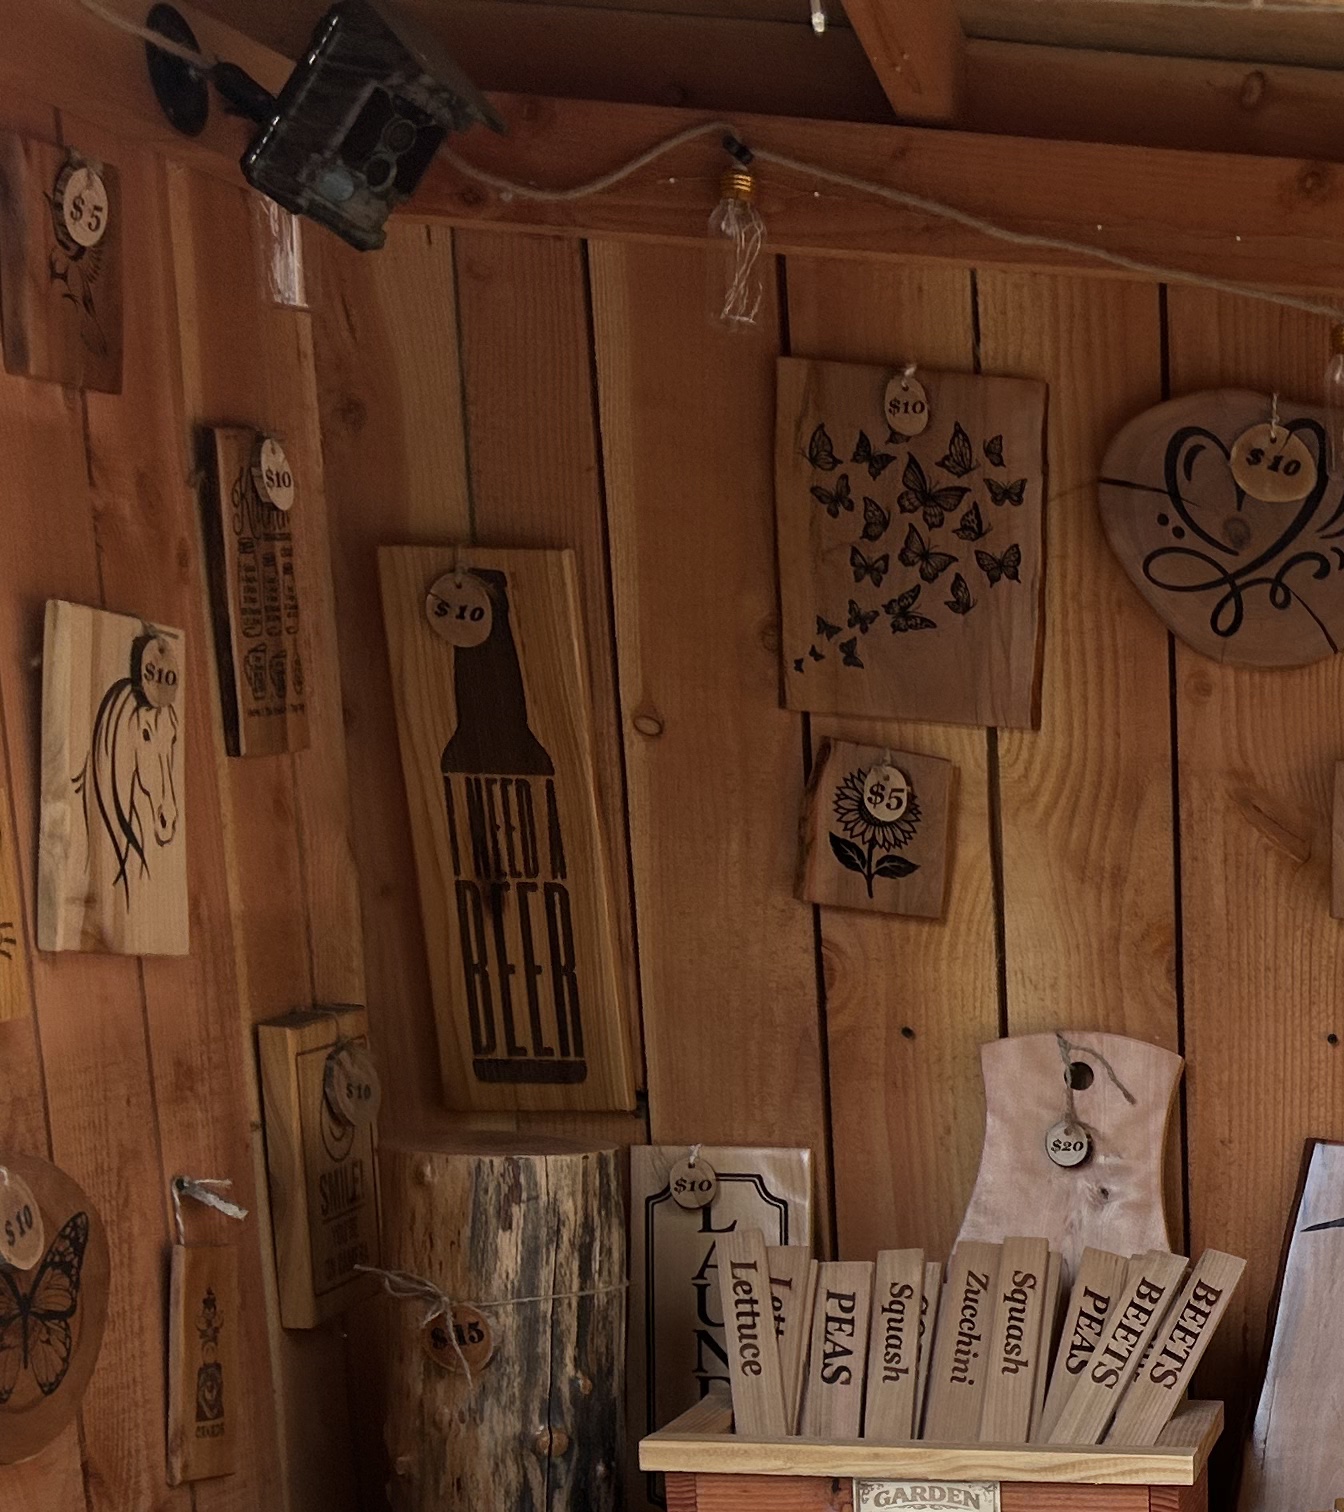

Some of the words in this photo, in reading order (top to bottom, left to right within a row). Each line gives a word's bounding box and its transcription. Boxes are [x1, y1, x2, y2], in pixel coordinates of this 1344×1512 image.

[887, 397, 925, 417] $10
[265, 468, 292, 490] $10
[143, 663, 178, 687] $10
[466, 776, 541, 879] NEED
[545, 777, 567, 880] A
[867, 781, 906, 814] $5
[455, 881, 585, 1059] BEER
[674, 1177, 712, 1194] $10
[1051, 1140, 1084, 1154] $20
[730, 1260, 763, 1377] Lettuce
[820, 1289, 856, 1386] PEAS
[881, 1281, 914, 1384] Squash
[950, 1270, 989, 1386] Zucchini
[1002, 1270, 1037, 1376] Squash
[1065, 1285, 1111, 1376] PEAS
[1090, 1276, 1166, 1391] BEETS
[1150, 1277, 1224, 1391] BEETS
[874, 1485, 980, 1510] GARDEN
